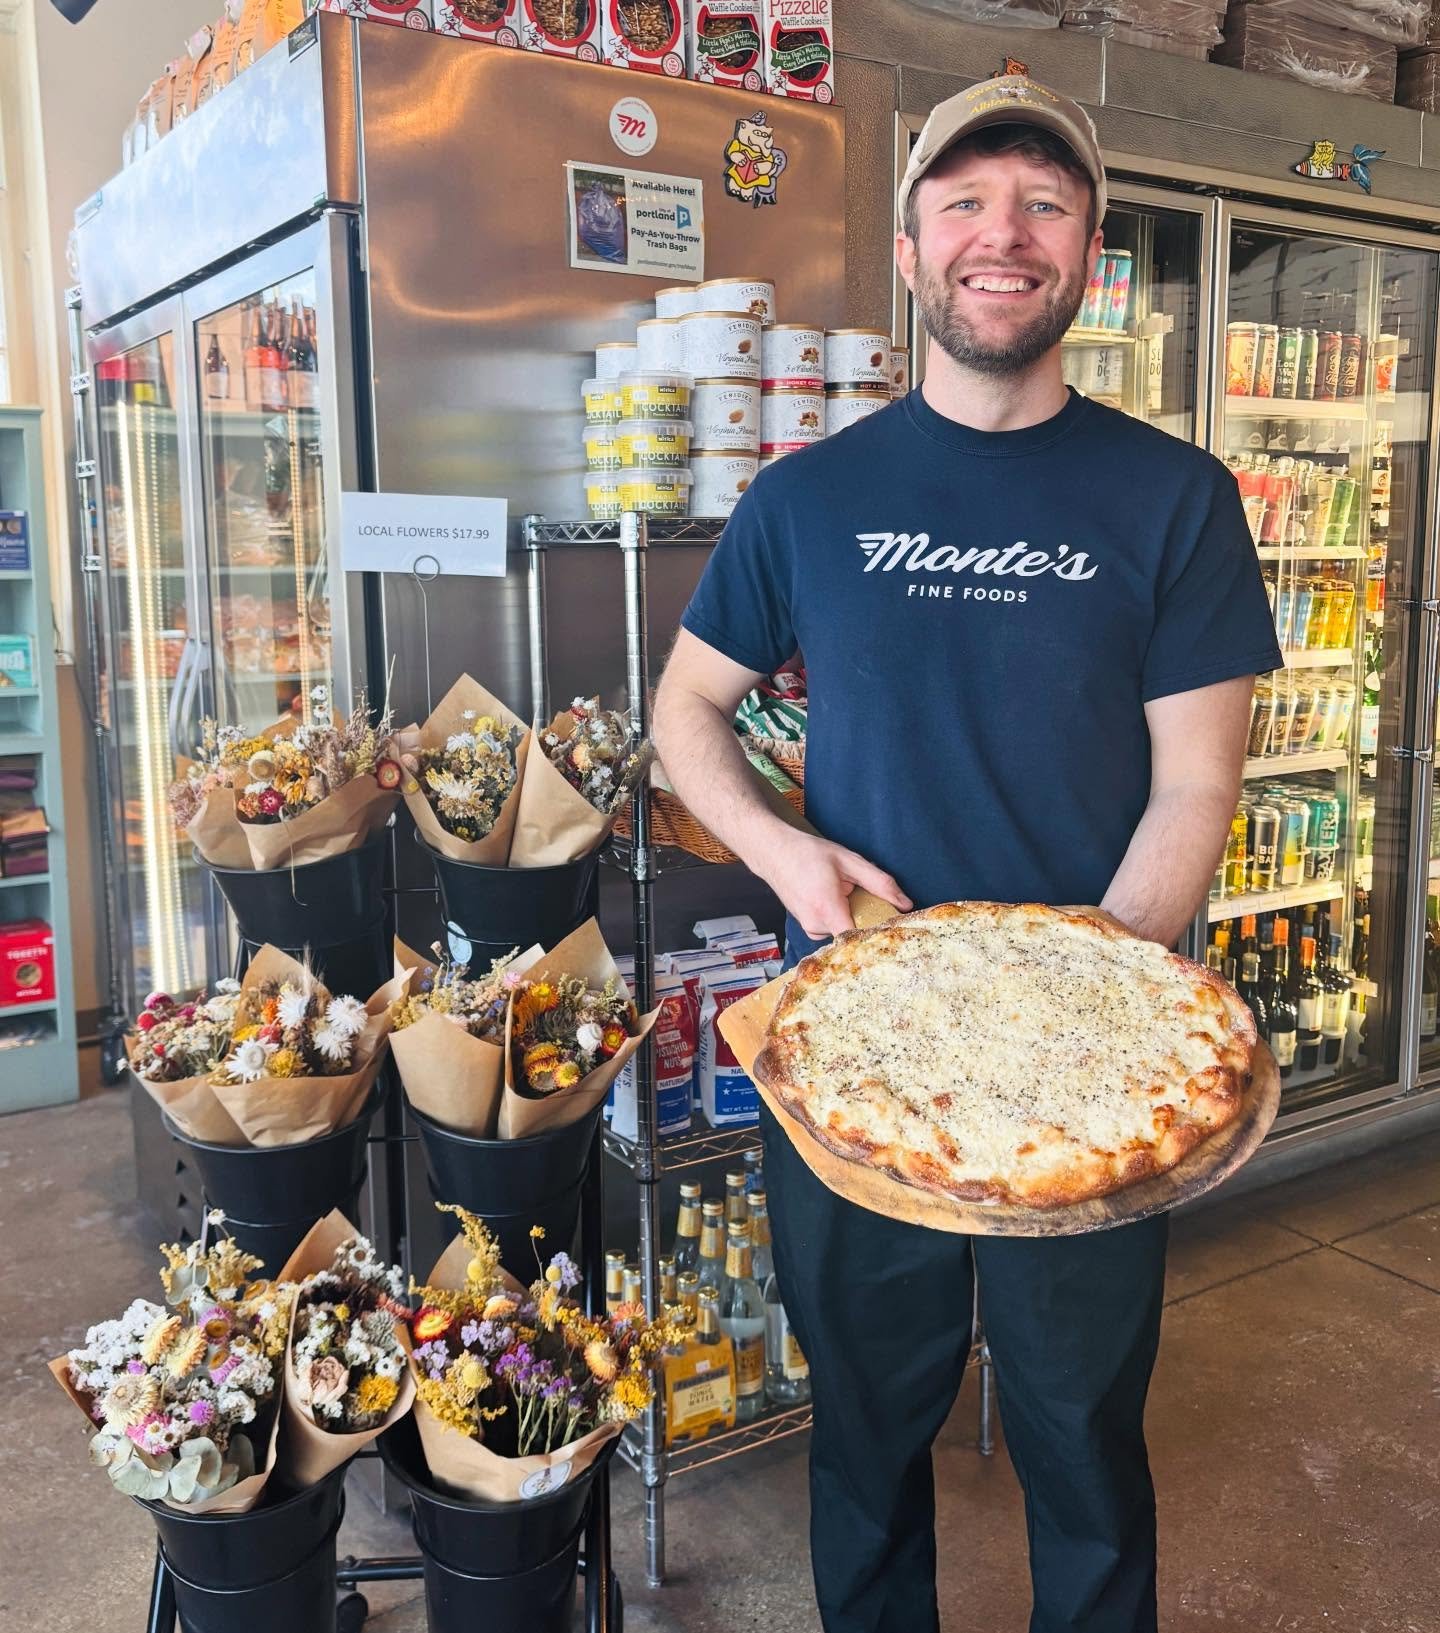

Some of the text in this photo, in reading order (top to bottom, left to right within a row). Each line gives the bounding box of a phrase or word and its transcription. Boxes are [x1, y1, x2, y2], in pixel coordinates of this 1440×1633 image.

[708, 3, 753, 12] Waffle Cookies
[780, 16, 822, 26] Waffle Cookies
[632, 181, 696, 197] Available Here!
[636, 209, 676, 221] portland
[631, 227, 700, 244] Pay-As-You-Throw
[646, 239, 688, 253] Trash Bags
[640, 403, 688, 413] COCKTAIL
[588, 456, 622, 465] COCKTA
[639, 452, 687, 462] COCKTAIL
[358, 525, 490, 540] LOCAL FLOWERS $17.99
[855, 532, 1099, 581] Monte's
[907, 584, 1028, 603] FINE FOODS
